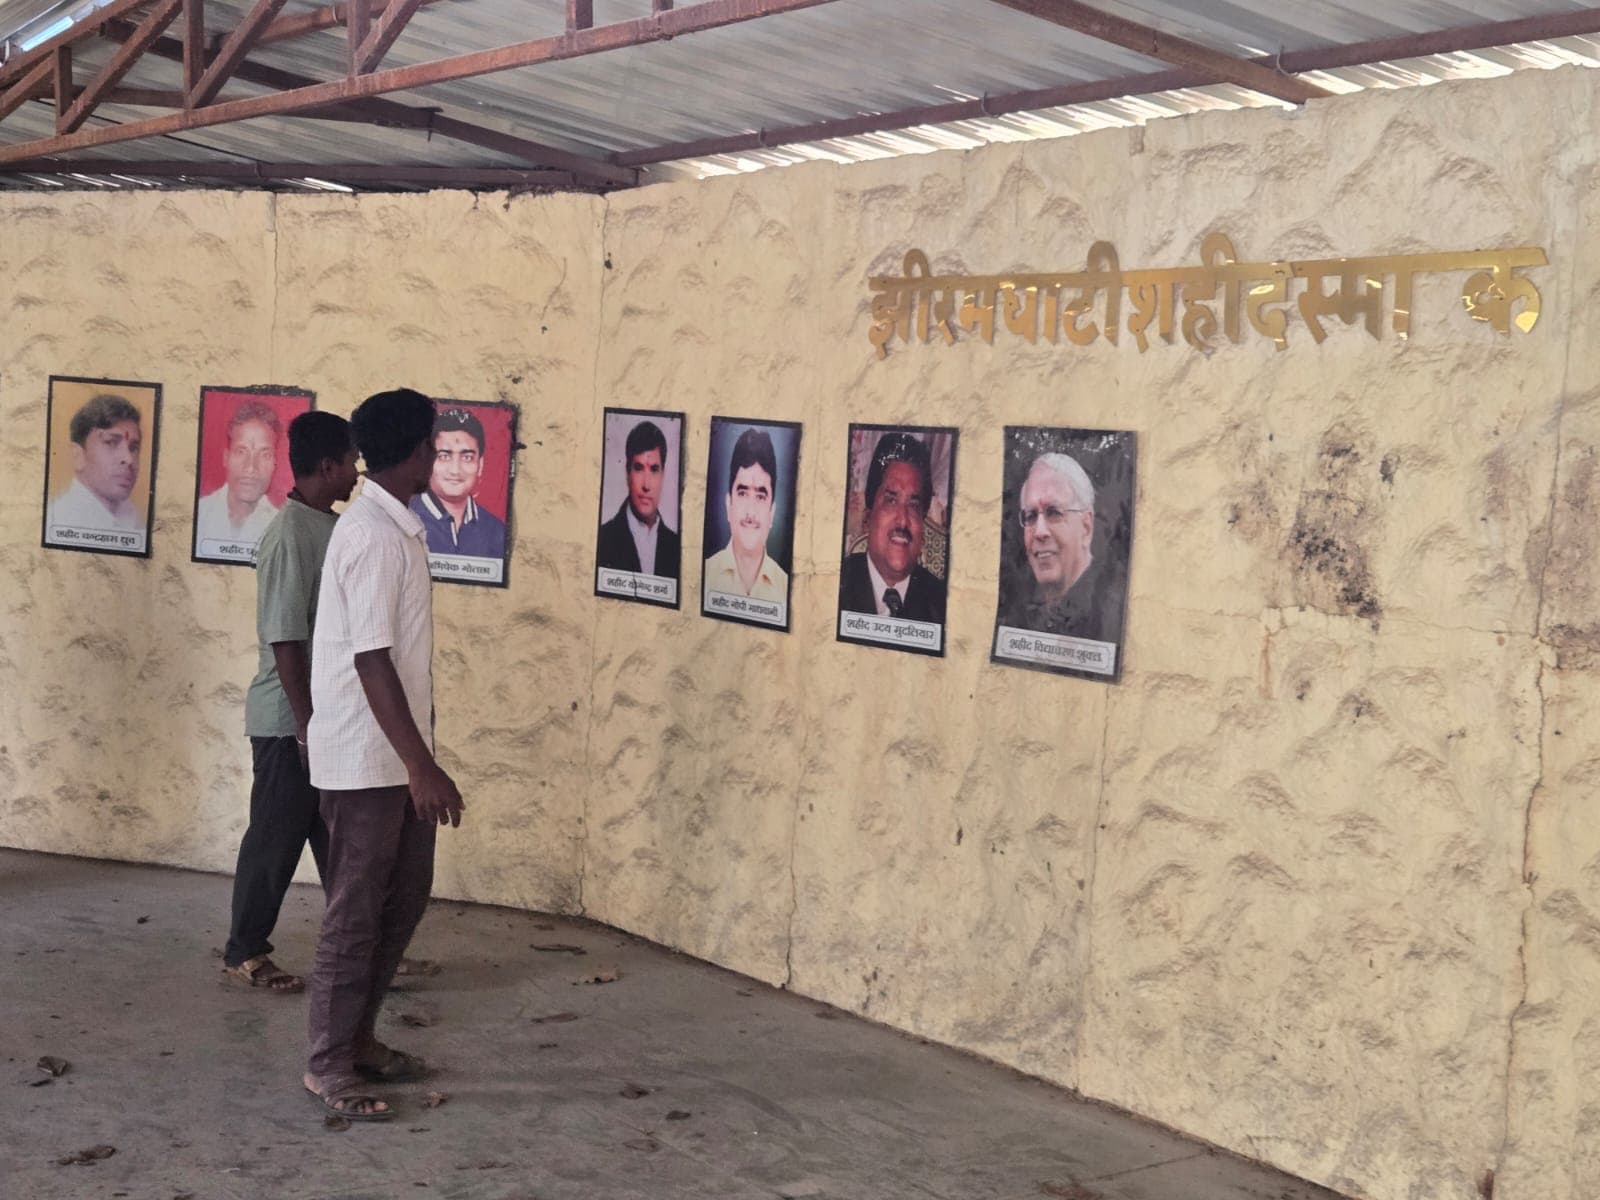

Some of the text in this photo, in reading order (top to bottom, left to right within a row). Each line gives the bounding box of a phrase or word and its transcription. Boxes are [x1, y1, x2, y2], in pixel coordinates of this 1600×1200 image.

[868, 232, 1550, 361] झीरम घाटी शहीद स्माक
[56, 530, 80, 539] शहीद
[219, 544, 245, 554] शहीद
[607, 576, 627, 587] शहीद
[711, 596, 730, 607] शहीद
[846, 618, 934, 639] शहीद उदय मुदलियार
[1009, 638, 1033, 651] शहीद
